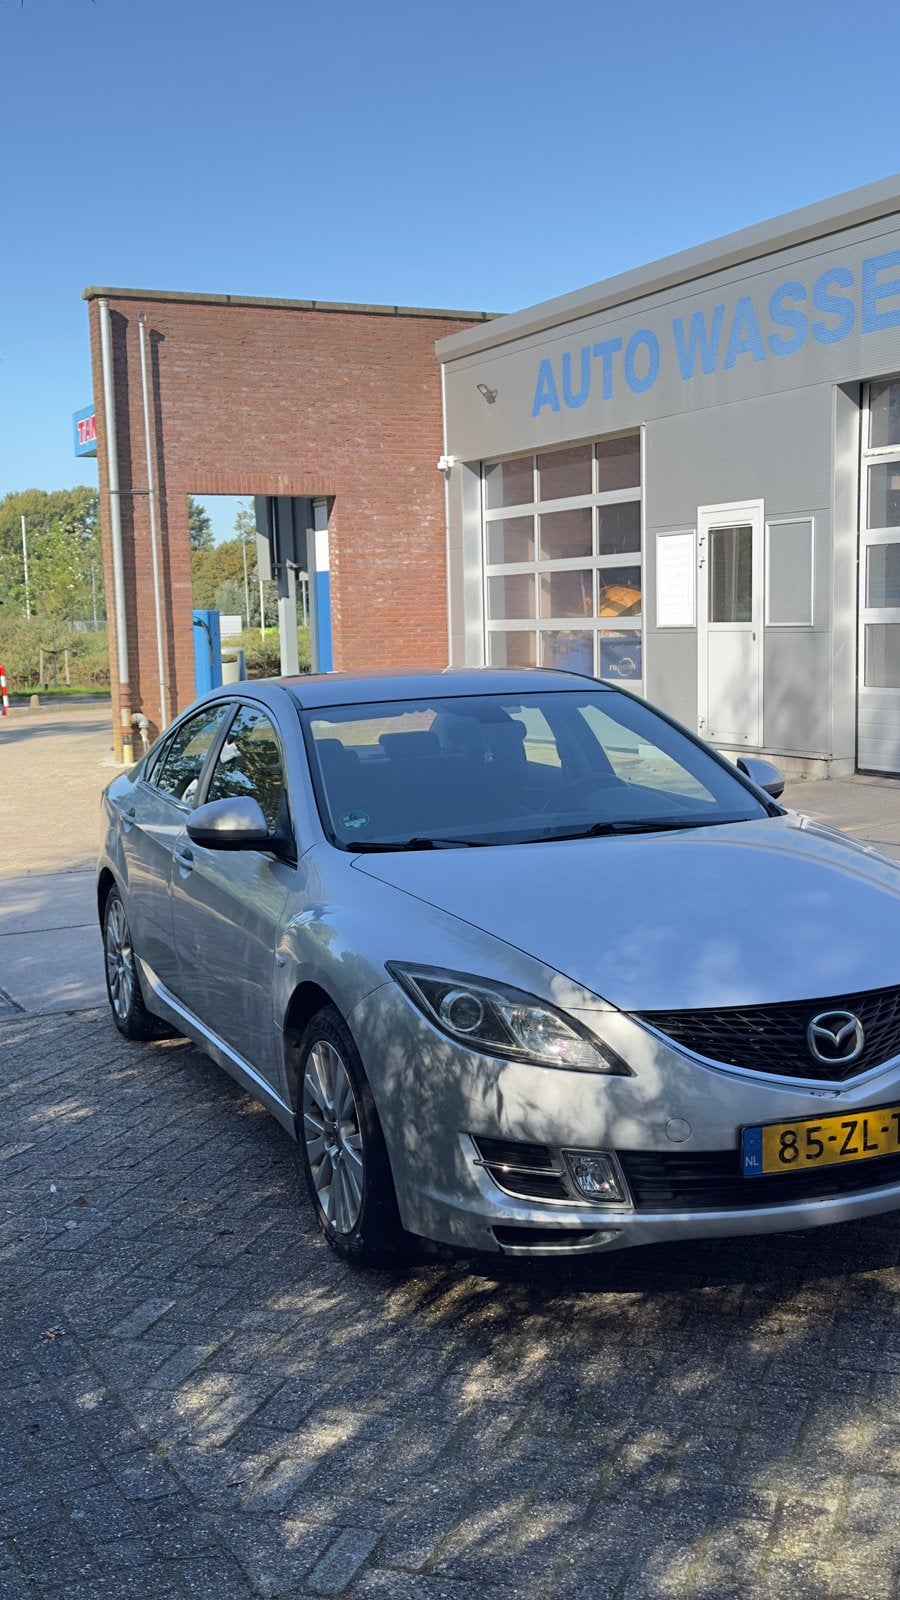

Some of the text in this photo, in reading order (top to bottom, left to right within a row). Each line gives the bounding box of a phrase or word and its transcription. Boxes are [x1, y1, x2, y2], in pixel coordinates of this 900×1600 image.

[532, 250, 900, 418] AUTO WASSE
[745, 1156, 759, 1166] NL
